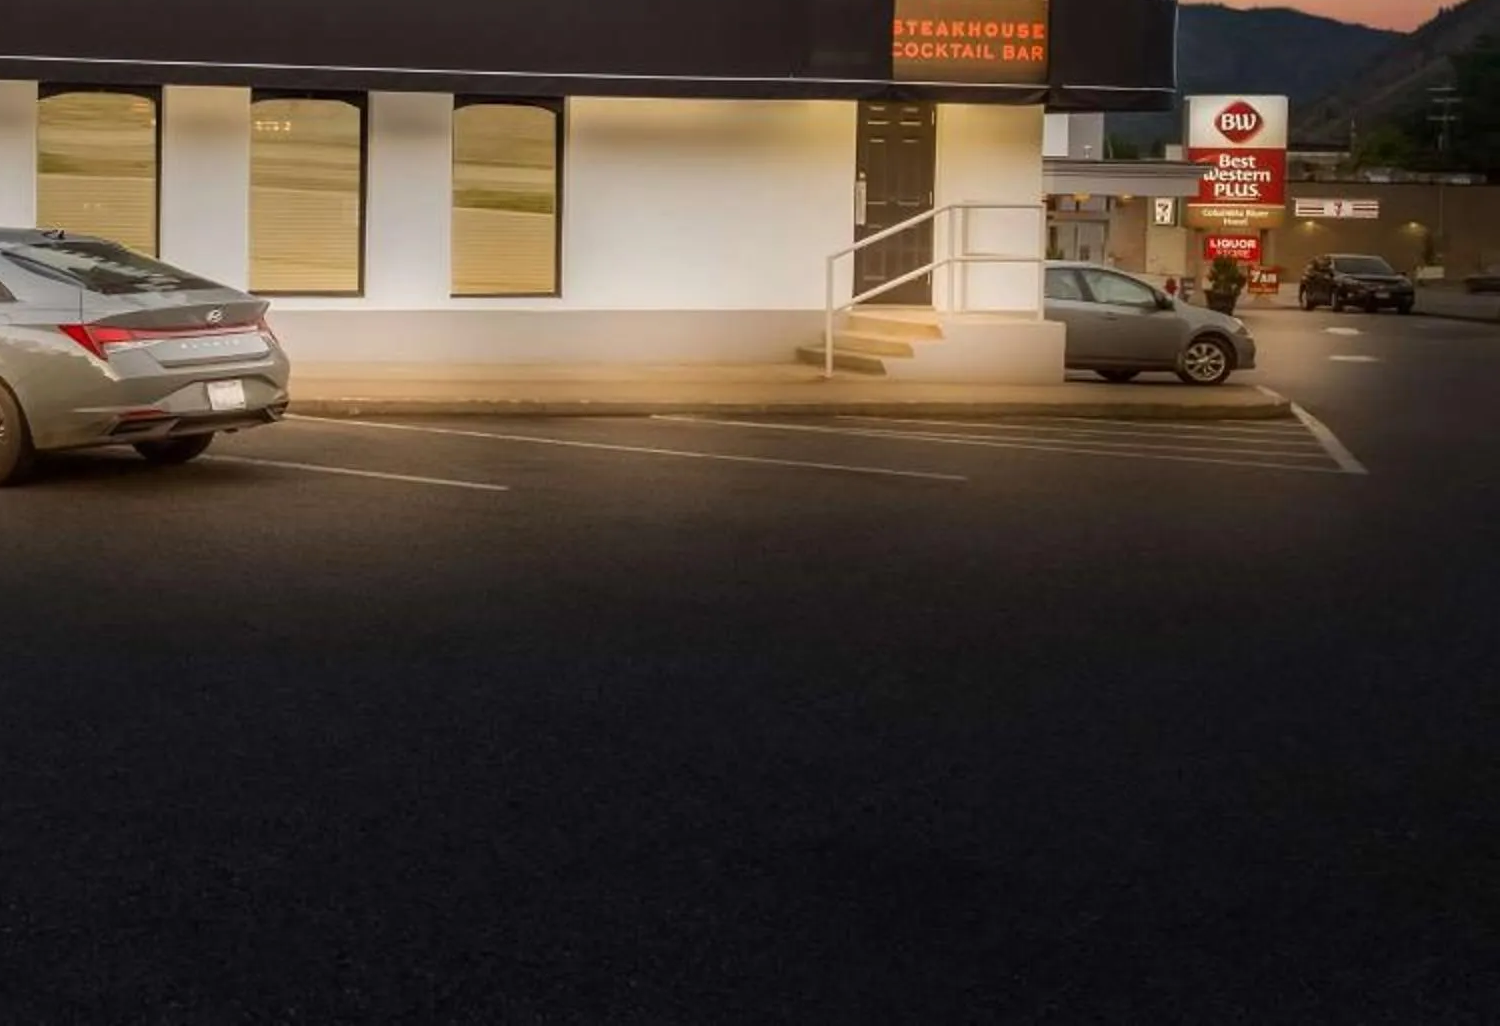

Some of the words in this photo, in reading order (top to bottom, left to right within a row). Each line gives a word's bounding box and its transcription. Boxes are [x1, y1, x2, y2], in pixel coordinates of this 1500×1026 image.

[892, 20, 1045, 39] STEAKHOUSE
[891, 42, 995, 60] COCKTAIL
[1003, 44, 1045, 61] BAR
[1220, 113, 1257, 131] BW
[1219, 153, 1257, 169] Best
[1208, 239, 1257, 249] LIQUOR
